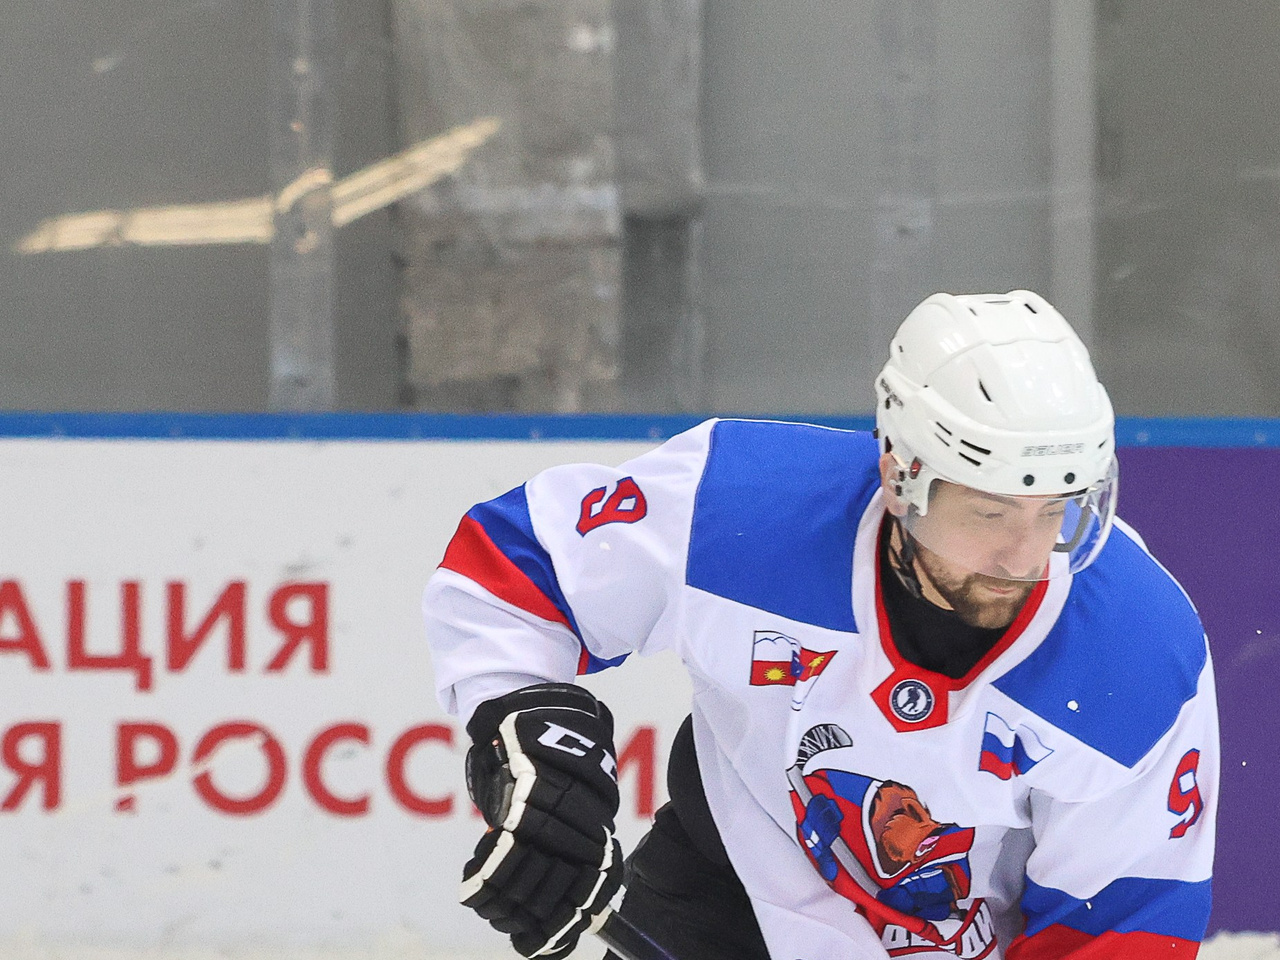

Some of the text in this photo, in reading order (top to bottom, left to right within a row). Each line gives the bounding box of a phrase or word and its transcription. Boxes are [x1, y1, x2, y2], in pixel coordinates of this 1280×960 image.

[575, 475, 648, 538] 9
[115, 720, 657, 817] РОСС
[1167, 747, 1204, 840] 9
